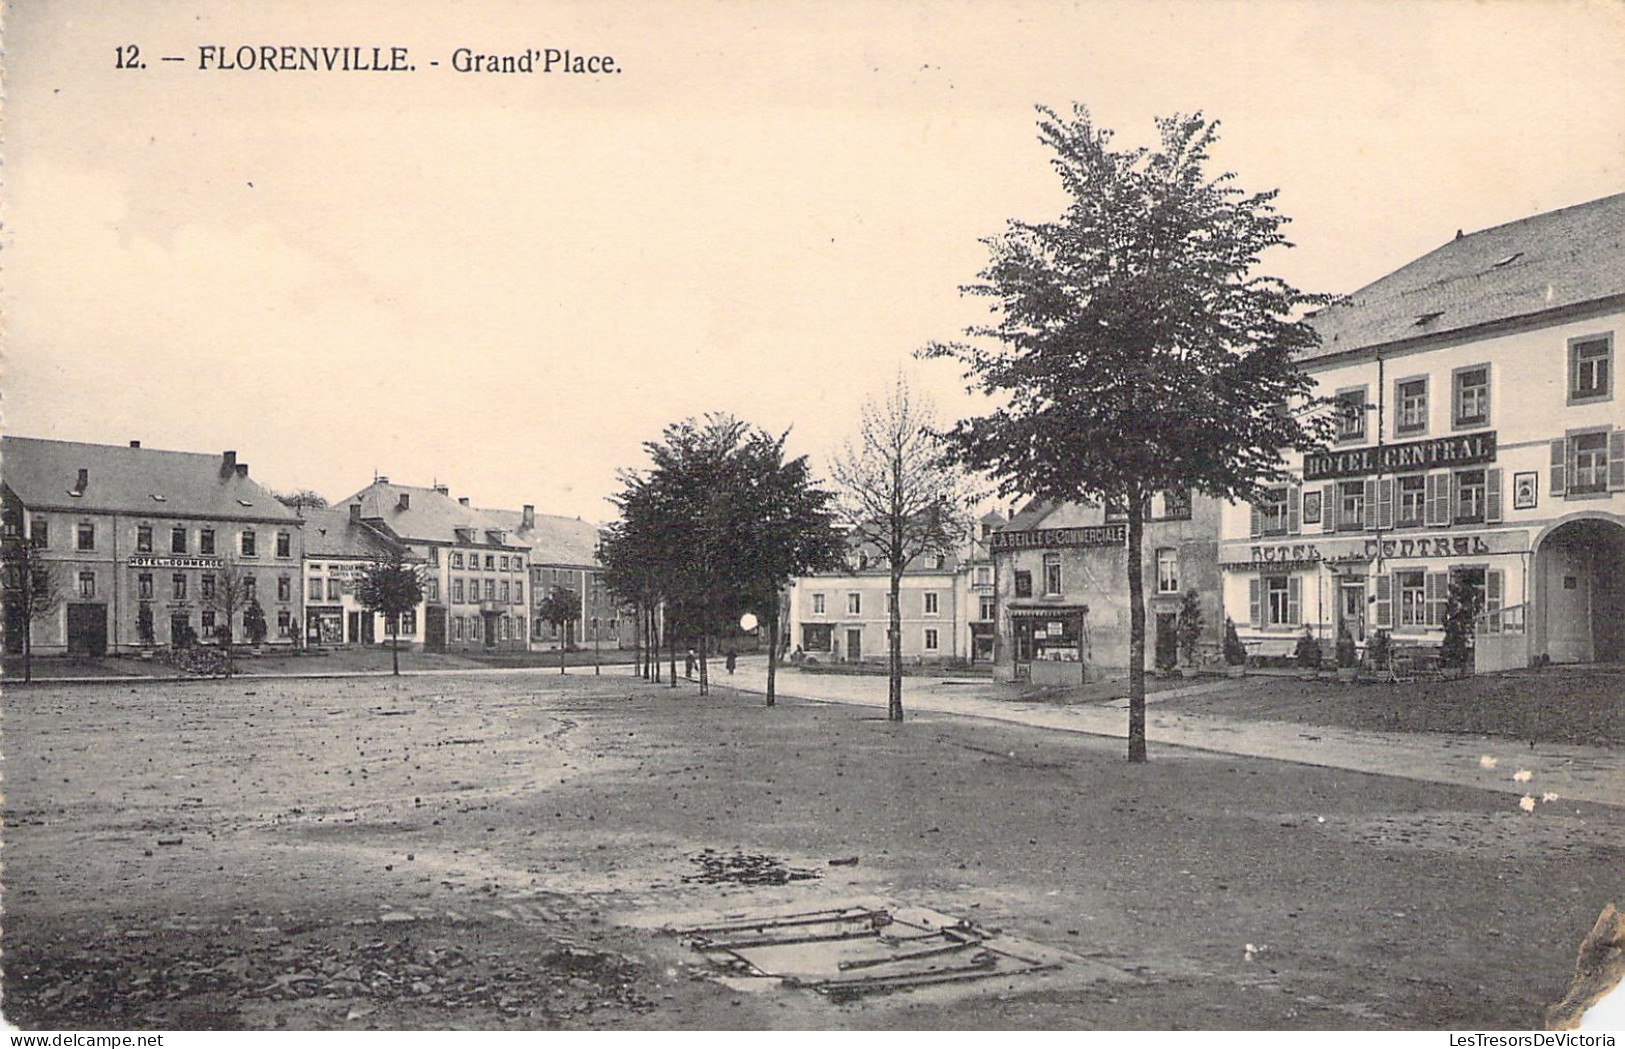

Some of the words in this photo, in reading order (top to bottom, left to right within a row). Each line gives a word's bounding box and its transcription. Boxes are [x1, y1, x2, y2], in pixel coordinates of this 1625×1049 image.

[1385, 438, 1489, 467] CENTRAL
[1056, 527, 1125, 545] COMMERCIALE
[1364, 536, 1489, 557] CENTRAL
[170, 559, 223, 567] COMMERCE
